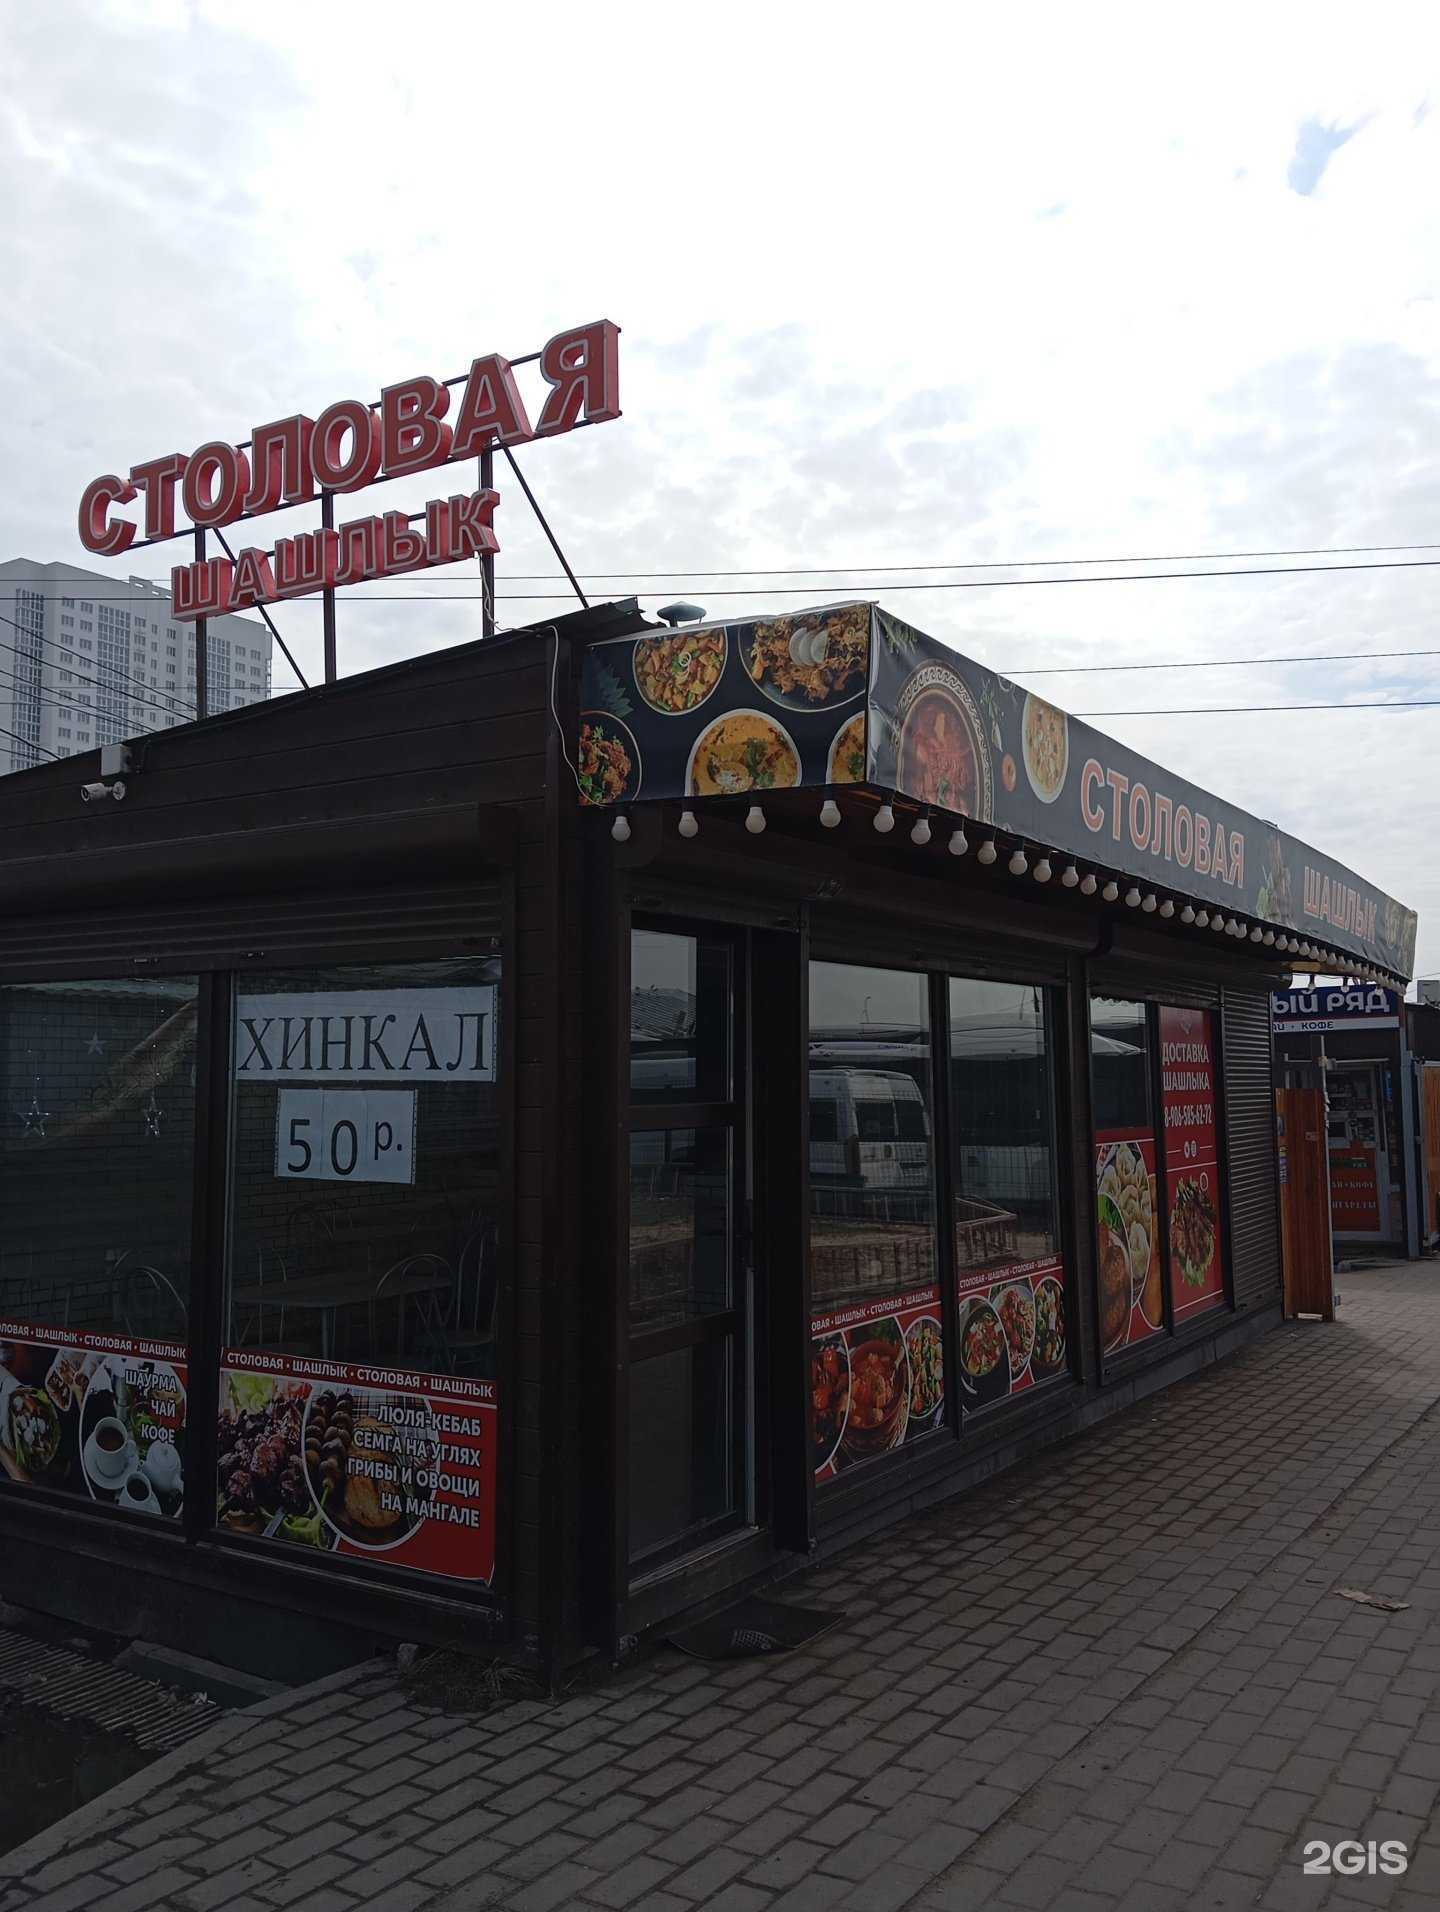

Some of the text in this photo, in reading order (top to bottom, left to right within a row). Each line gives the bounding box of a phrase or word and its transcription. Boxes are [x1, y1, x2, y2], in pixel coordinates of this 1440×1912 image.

[79, 319, 622, 556] СТОЛОВАЯ
[171, 488, 501, 622] ШАШЛЫК
[1080, 757, 1377, 945] СТОЛОВАЯ ШАШЛЫК
[238, 1012, 489, 1071] ХИНКАЛ
[1301, 1021, 1334, 1031] КОФЕ
[1161, 1042, 1210, 1066] ДОСТАВКА
[1162, 1072, 1211, 1091] ШАШЛЫКА
[287, 1118, 358, 1176] 50
[835, 1308, 867, 1325] ШАШЛЫК
[870, 1298, 902, 1315] СТОЛОВАЯ
[36, 1327, 78, 1344] ШАШЛЫК
[84, 1334, 132, 1351] СТОЛОВАЯ
[139, 1342, 187, 1359] ШАШЛЫК
[125, 1370, 177, 1393] ШАУРМА
[227, 1352, 494, 1398] СТОЛОВАЯ ШАШЛЫК СТОЛОВАЯ ШАШЛЫК
[151, 1398, 176, 1418] ЧАЙ
[377, 1405, 481, 1437] ЛЮЛЯ-КЕБАБ
[141, 1423, 176, 1444] КОФЕ
[353, 1430, 481, 1467] СЕМГА НА УГЛЯХ
[347, 1458, 480, 1497] ГРИБЫ И ОВОЩИ
[381, 1492, 480, 1529] НА МАНГАЛЕ
